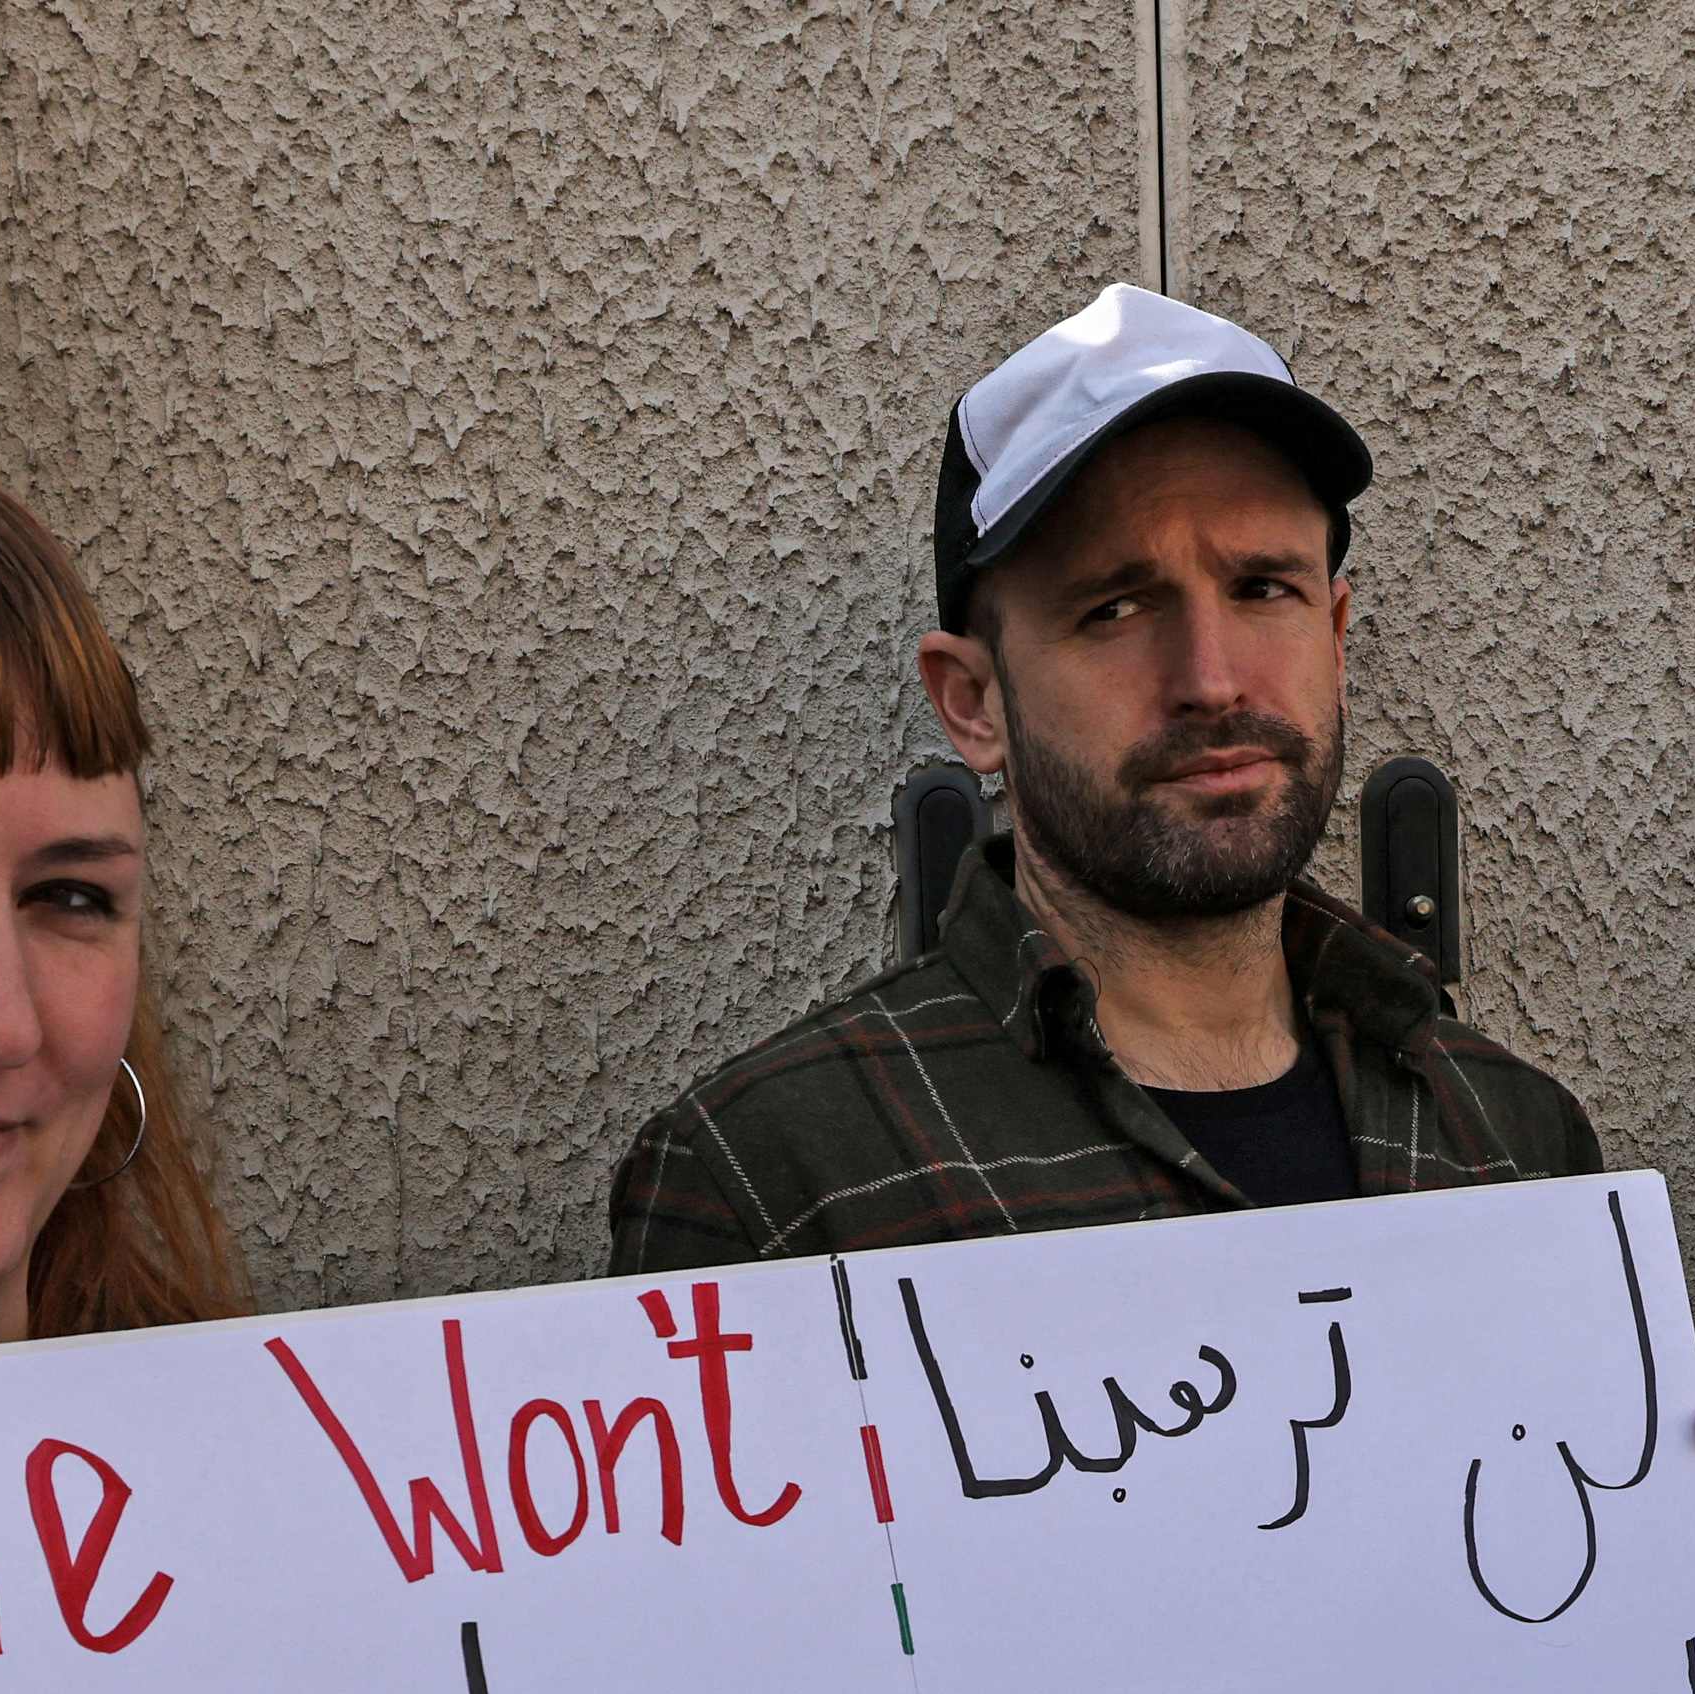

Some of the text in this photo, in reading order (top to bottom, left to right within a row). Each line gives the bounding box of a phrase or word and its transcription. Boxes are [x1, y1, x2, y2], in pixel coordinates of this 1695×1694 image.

[264, 1282, 802, 1583] Won't
[898, 1191, 1658, 1623] لن ترهبنا
